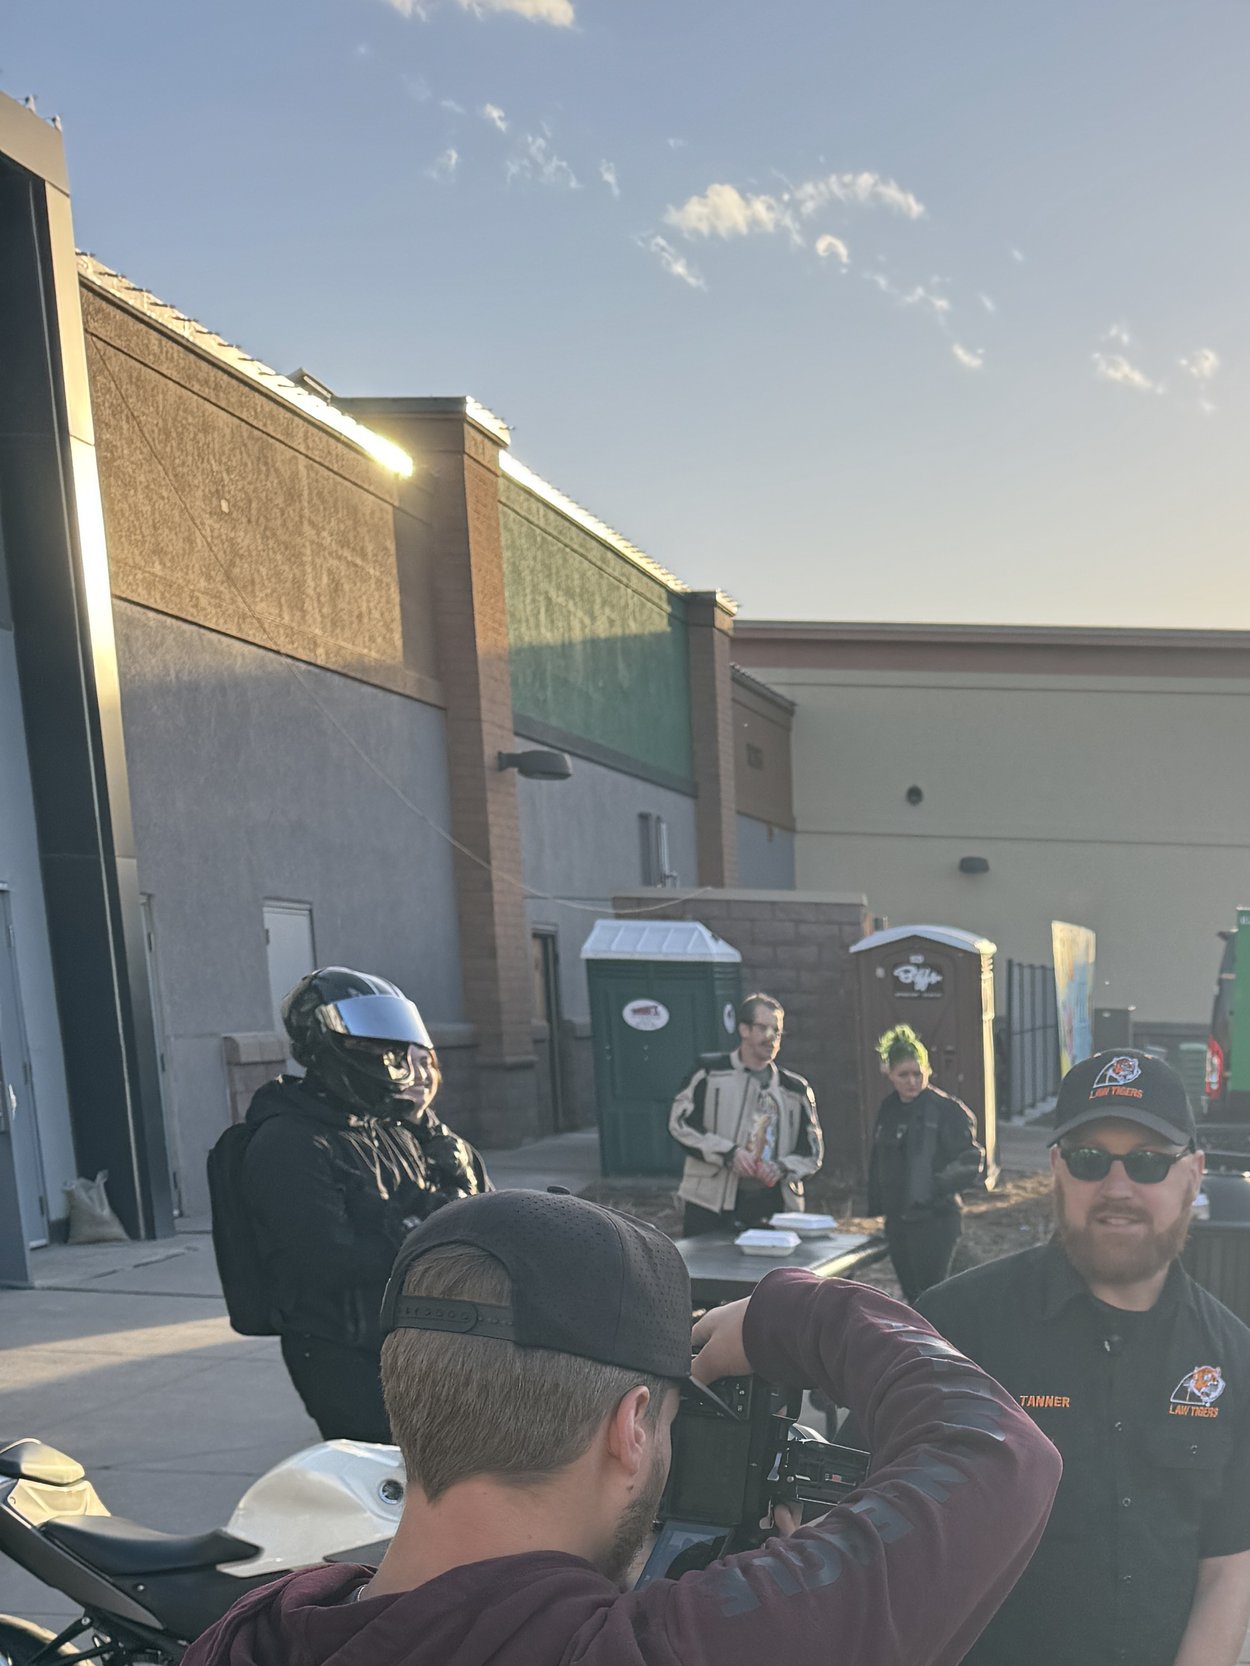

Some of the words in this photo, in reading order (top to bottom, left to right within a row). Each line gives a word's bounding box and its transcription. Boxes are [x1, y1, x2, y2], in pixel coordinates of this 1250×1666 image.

[1088, 1087, 1110, 1100] LAW
[1111, 1086, 1143, 1098] TIGERS
[1019, 1395, 1070, 1408] TANNER
[1168, 1404, 1190, 1416] LAW
[1190, 1405, 1219, 1418] TIGERS
